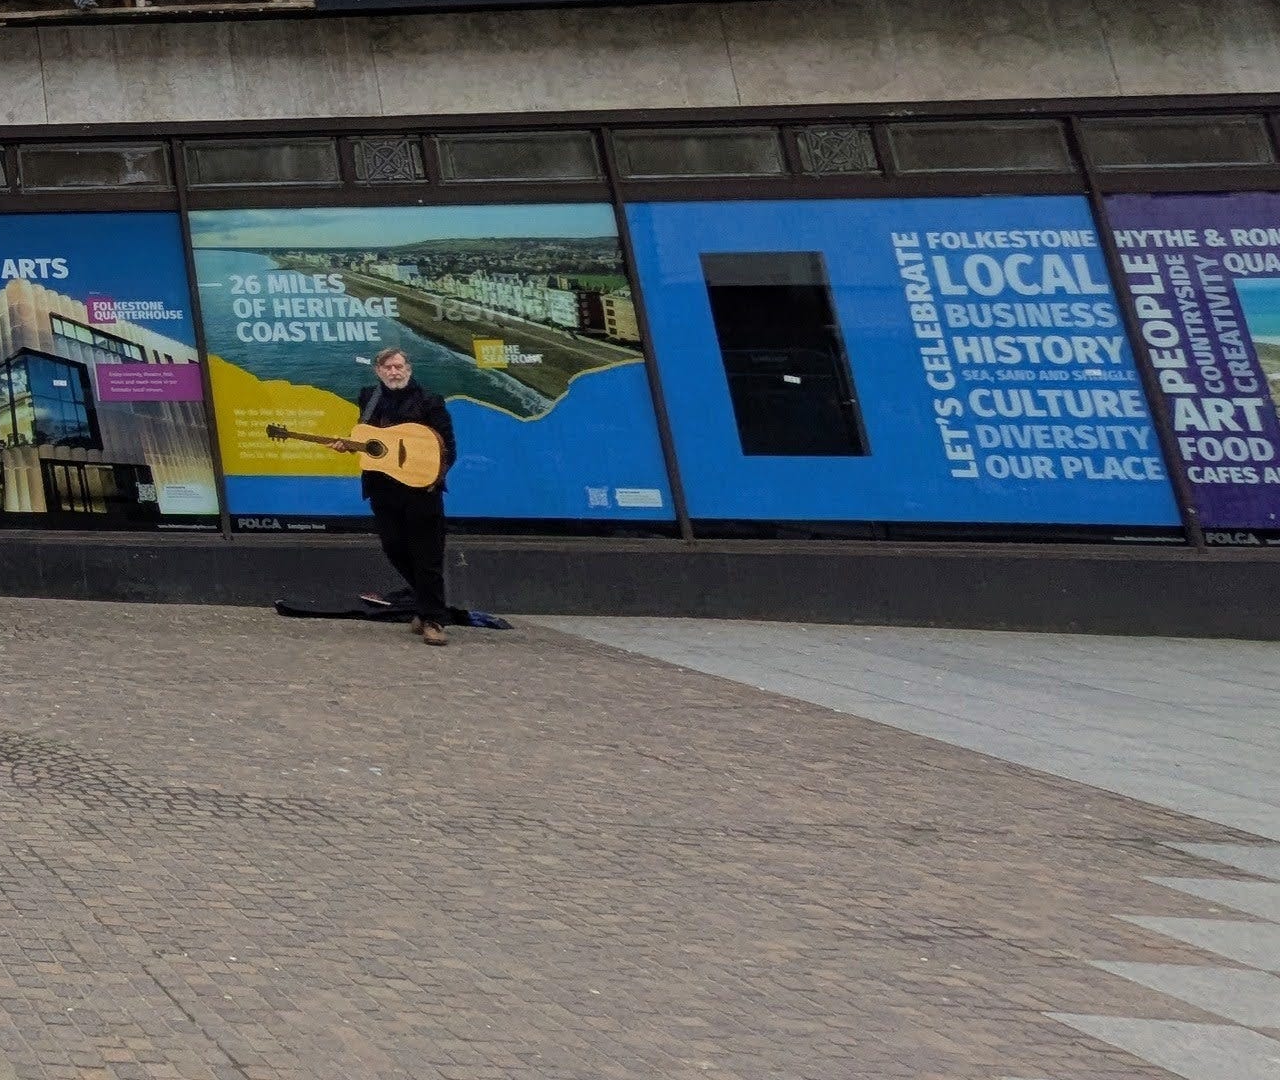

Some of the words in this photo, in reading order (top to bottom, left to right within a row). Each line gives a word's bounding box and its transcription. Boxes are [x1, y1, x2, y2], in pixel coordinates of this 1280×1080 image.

[926, 229, 1097, 249] FOLKESTONE
[1112, 228, 1200, 248] HYTHE
[1203, 228, 1228, 248] &
[0, 257, 70, 280] ARTS
[932, 253, 1110, 297] LOCAL
[228, 274, 261, 295] 26
[267, 273, 346, 295] MILES
[92, 301, 164, 311] FOLKESTONE
[93, 310, 184, 321] QUARTERHOUSE
[232, 298, 266, 319] OF
[272, 297, 400, 318] HERITAGE
[891, 231, 957, 391] CELEBRATE
[944, 302, 1119, 329] BUSINESS
[236, 321, 382, 343] COASTLINE
[1121, 253, 1198, 394] PEOPLE
[1164, 253, 1225, 394] COUNTRYSIDE
[1194, 255, 1259, 394] CREATIVITY
[481, 354, 544, 365] SEAFROT
[952, 335, 1124, 365] HISTORY
[962, 369, 995, 383] SEA,
[997, 369, 1037, 381] SAND
[1040, 369, 1069, 381] AND
[968, 388, 1147, 418] CULTURE
[1174, 397, 1264, 432] ART
[934, 396, 979, 479] LET'S
[975, 424, 1150, 450] DIVERSITY
[1179, 436, 1275, 462] FOOD
[984, 455, 1058, 479] OUR
[1060, 455, 1167, 481] PLACE
[1188, 466, 1261, 484] CAFES
[1263, 467, 1280, 484] A
[237, 518, 282, 530] FOLCA
[1205, 532, 1261, 545] FOLCA
